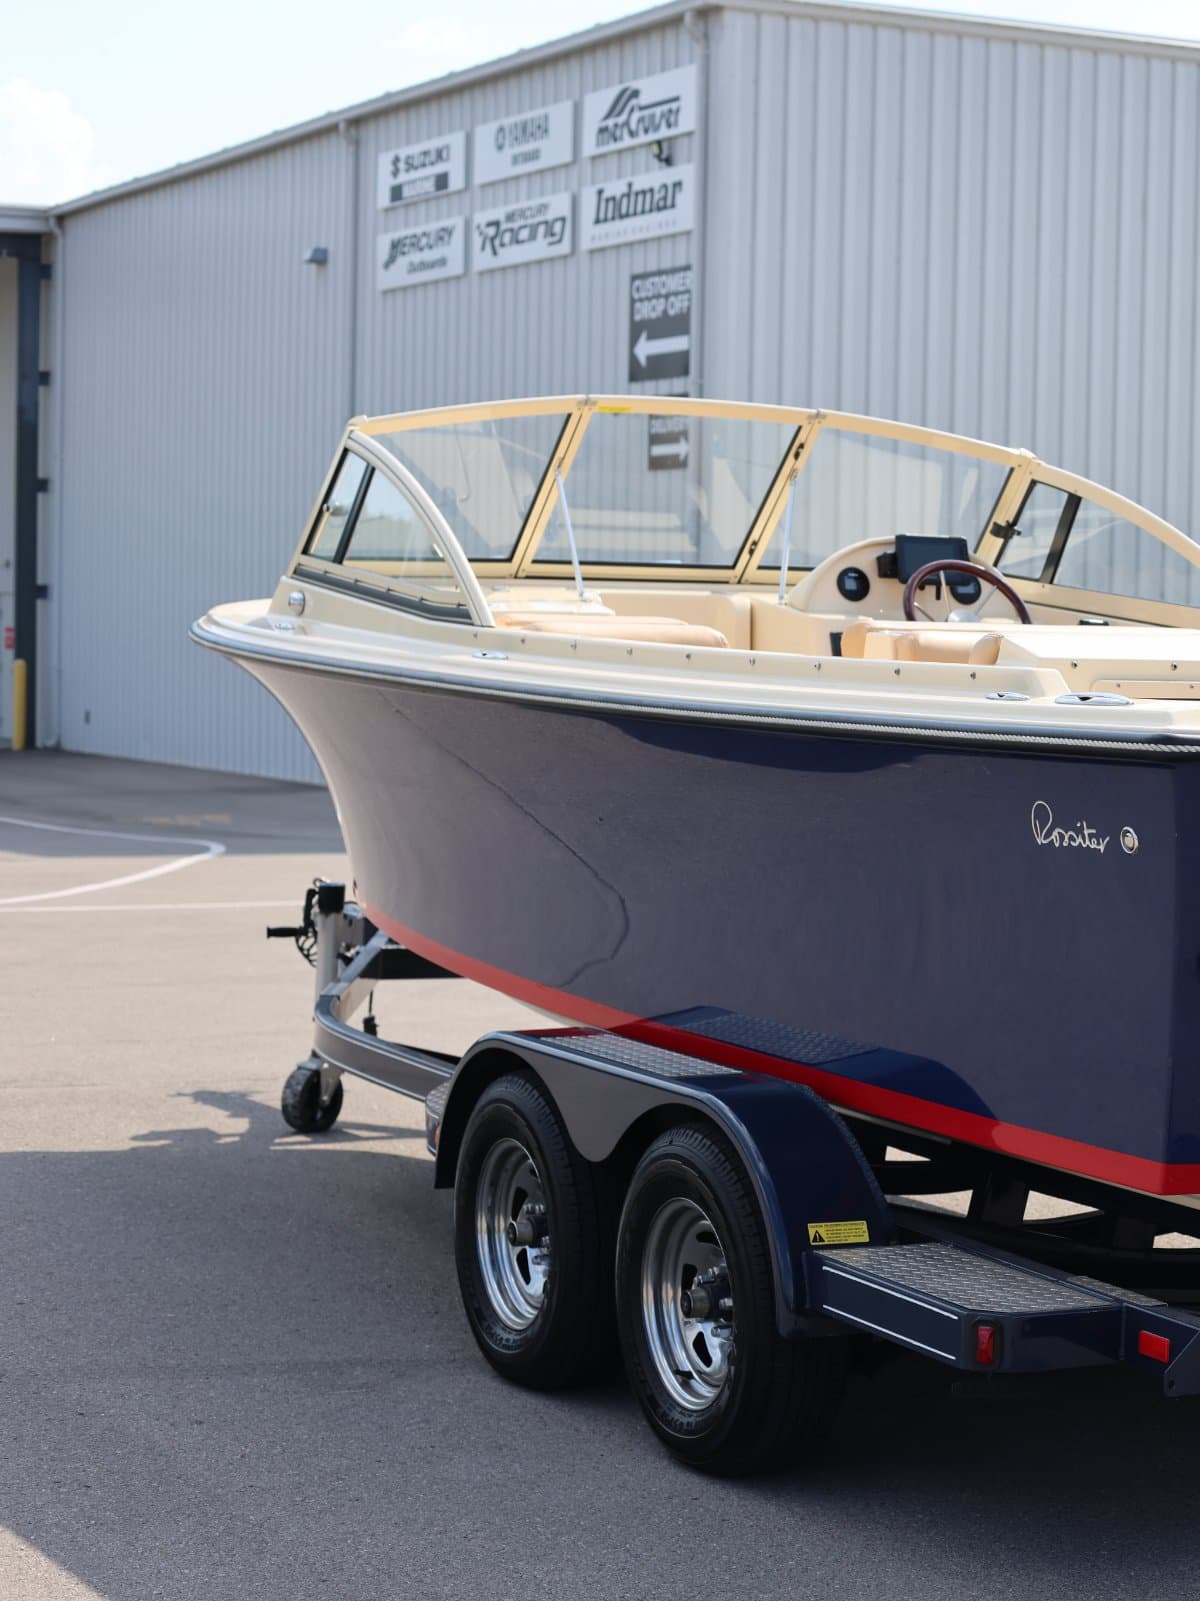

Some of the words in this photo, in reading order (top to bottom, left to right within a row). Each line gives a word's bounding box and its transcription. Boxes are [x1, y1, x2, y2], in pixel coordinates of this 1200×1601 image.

[508, 112, 549, 149] YAMAHA
[404, 143, 450, 173] SUZUKI
[505, 203, 549, 223] MERCURY
[593, 181, 683, 225] Indmar
[383, 225, 456, 272] MERCURY
[482, 216, 567, 256] Racing
[632, 271, 690, 300] CUSTOMER
[634, 298, 665, 321] DROP
[667, 294, 688, 316] OFF
[1031, 800, 1110, 853] Rossiter
